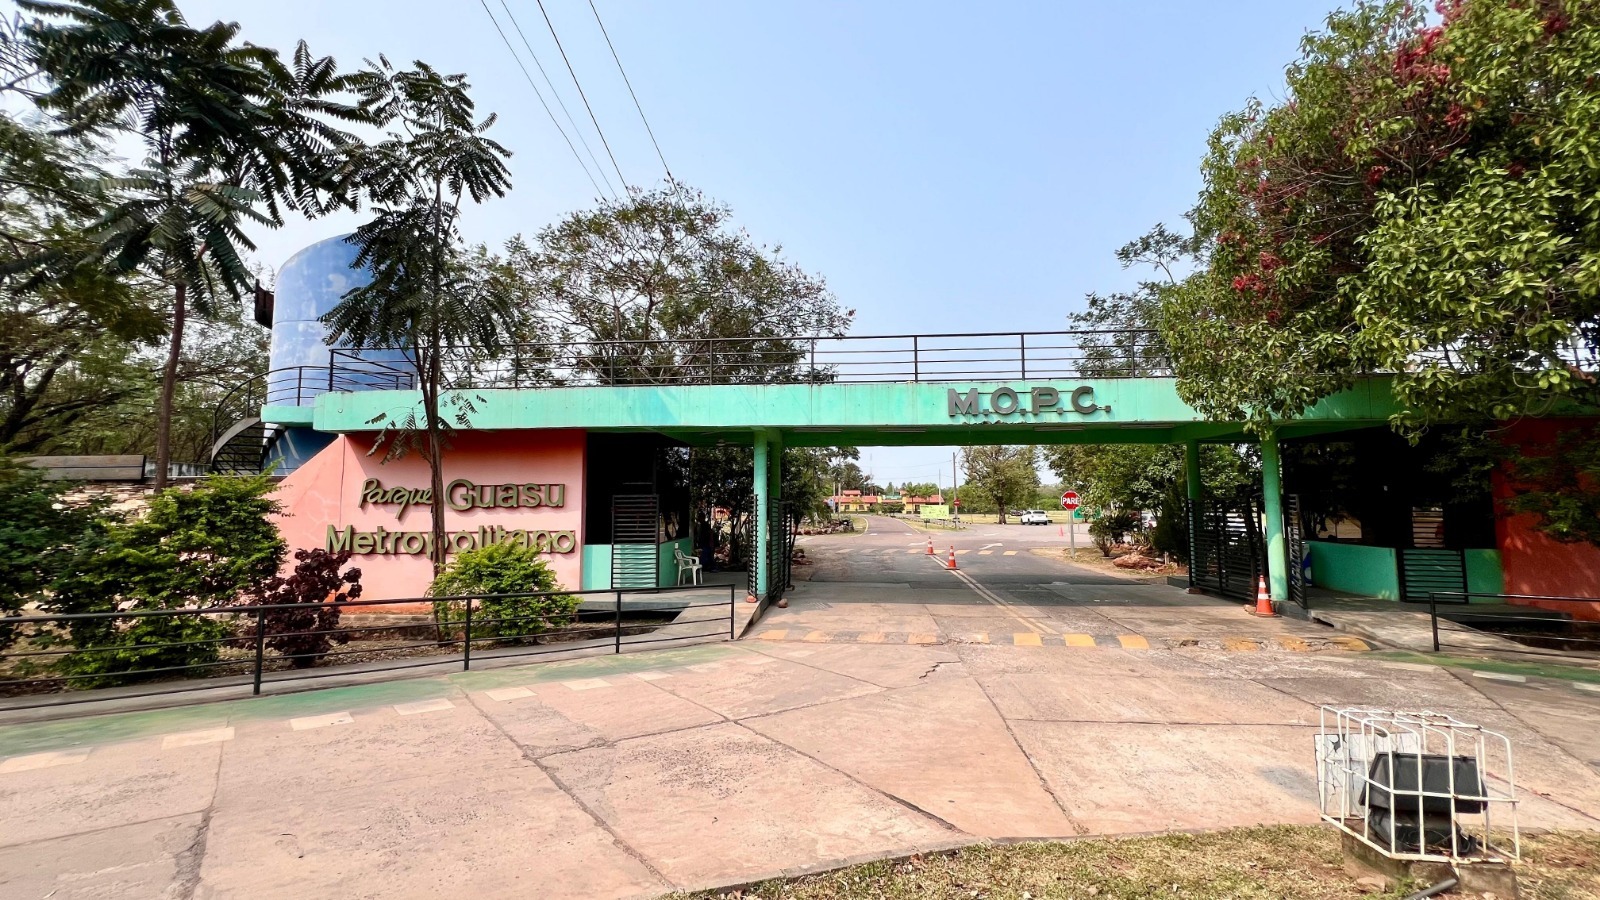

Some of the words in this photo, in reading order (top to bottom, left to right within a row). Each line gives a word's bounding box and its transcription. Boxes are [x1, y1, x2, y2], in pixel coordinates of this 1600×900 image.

[948, 386, 1111, 416] M.O.P.C.
[358, 478, 433, 519] Parque
[445, 478, 565, 511] Guasu
